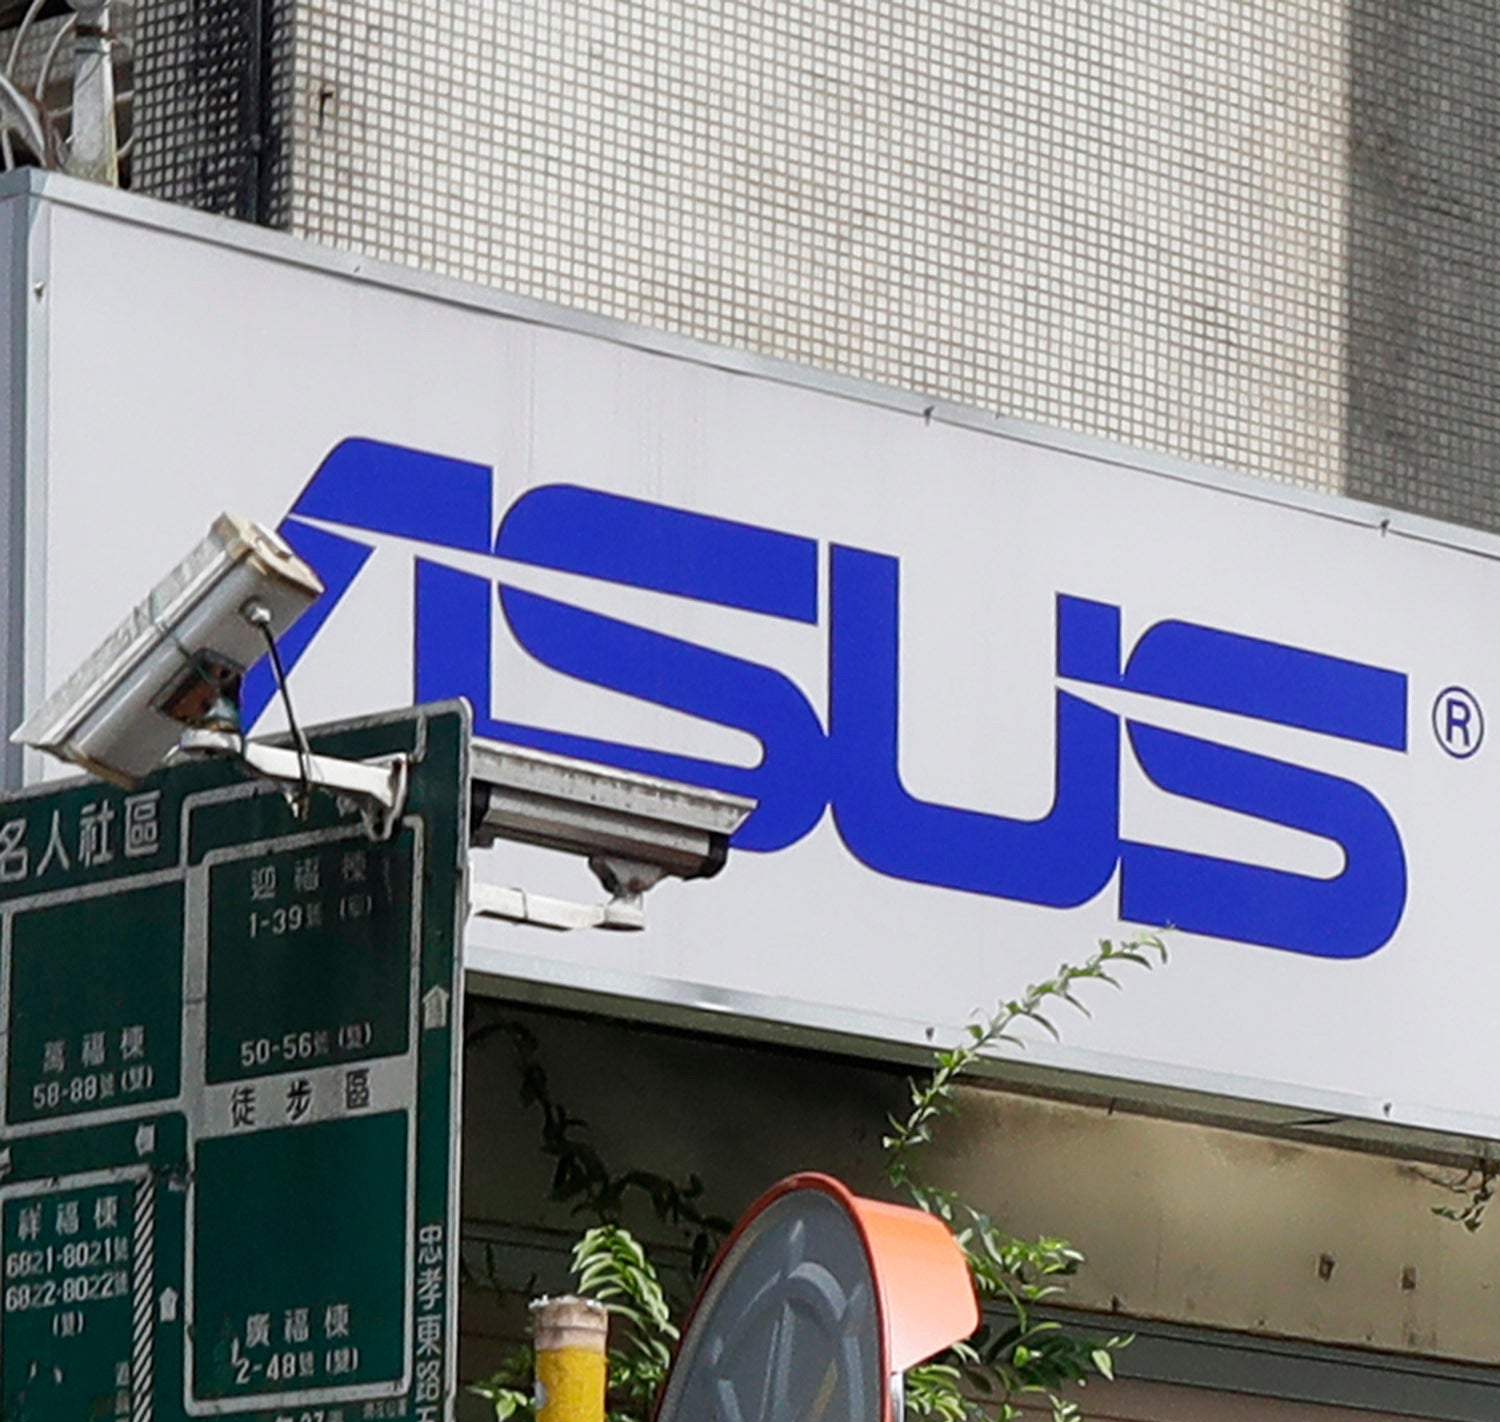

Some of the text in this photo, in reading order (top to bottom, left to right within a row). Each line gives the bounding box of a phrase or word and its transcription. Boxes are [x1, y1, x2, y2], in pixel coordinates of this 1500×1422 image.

[237, 438, 1408, 960] ASUS
[231, 1067, 370, 1128] 徒步區
